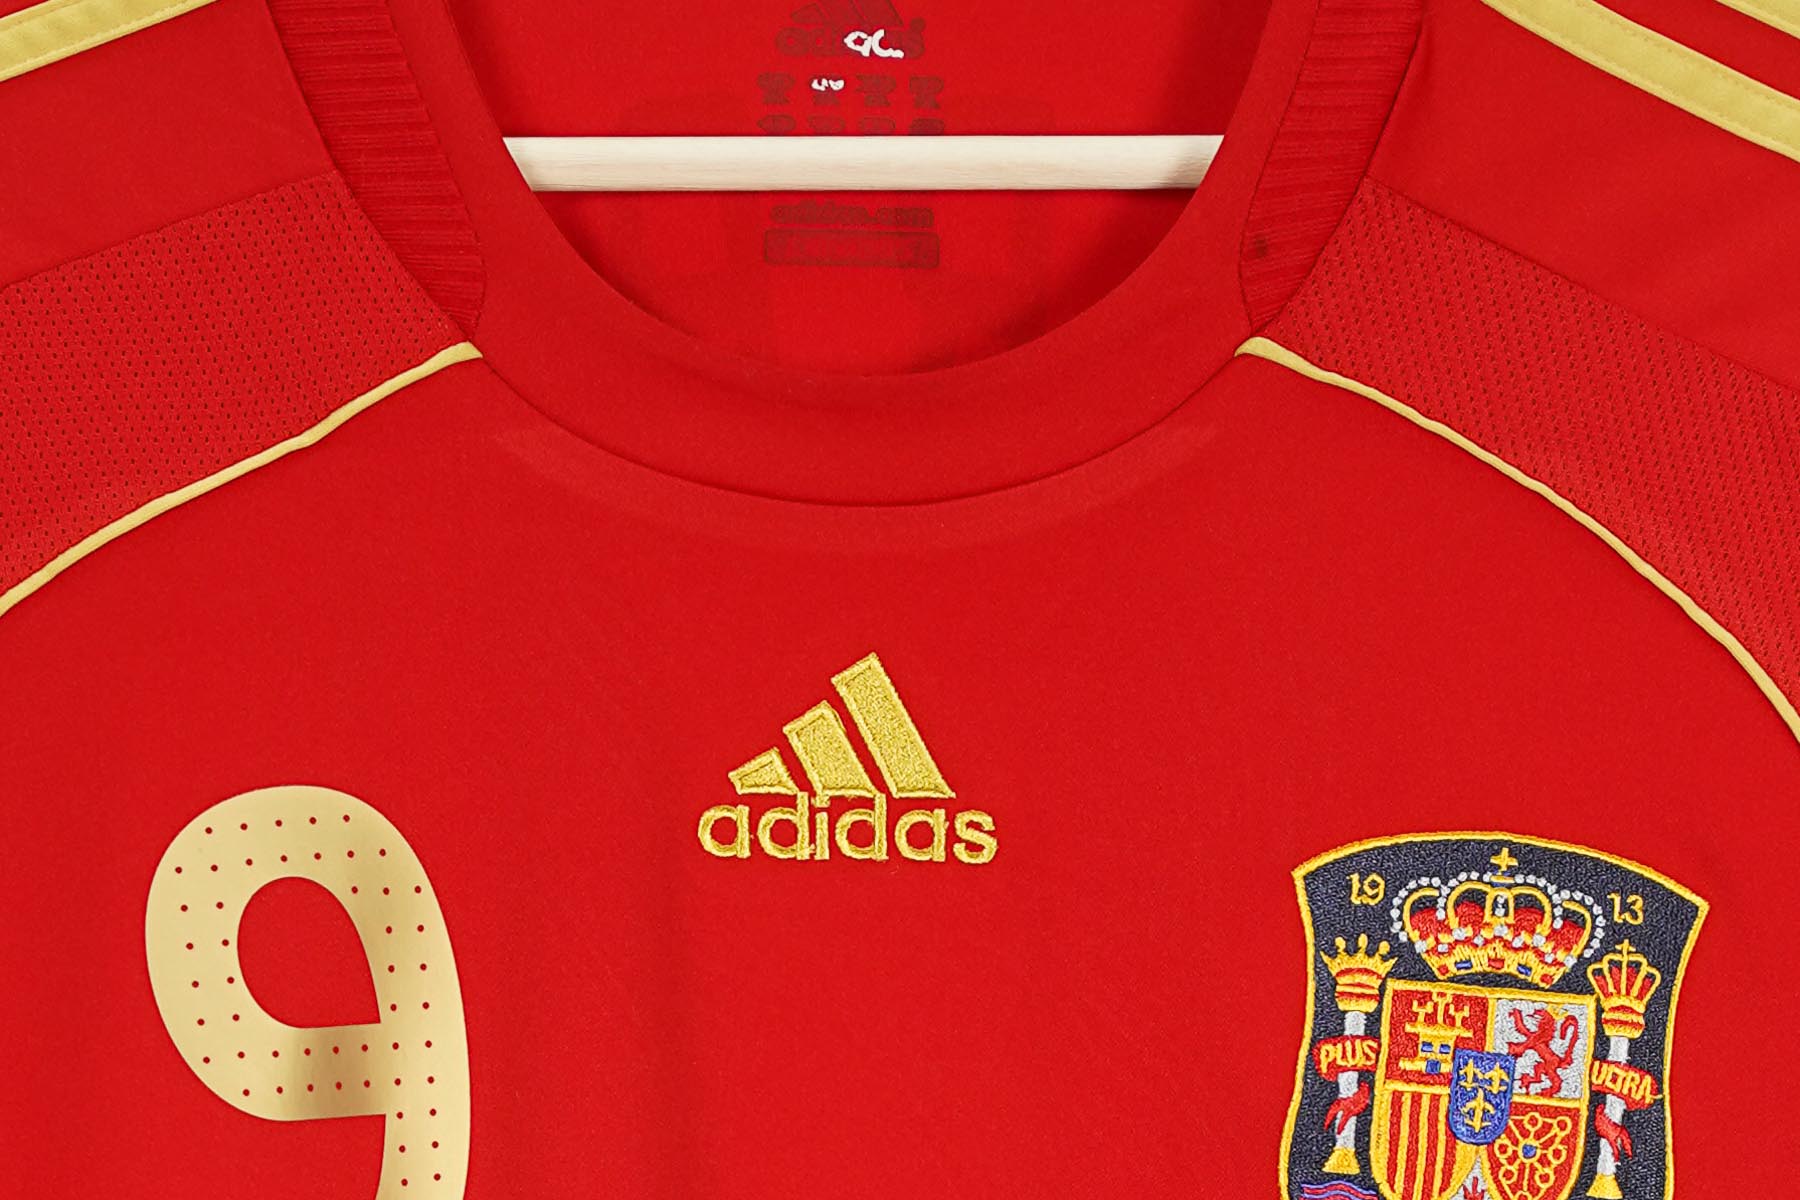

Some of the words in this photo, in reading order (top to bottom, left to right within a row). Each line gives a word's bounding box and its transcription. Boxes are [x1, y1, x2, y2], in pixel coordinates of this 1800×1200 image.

[698, 791, 998, 864] adidas
[1345, 872, 1386, 906] 19
[1606, 892, 1644, 925] 13
[1319, 1038, 1378, 1074] PLUS
[1591, 1060, 1657, 1105] ULTRA
